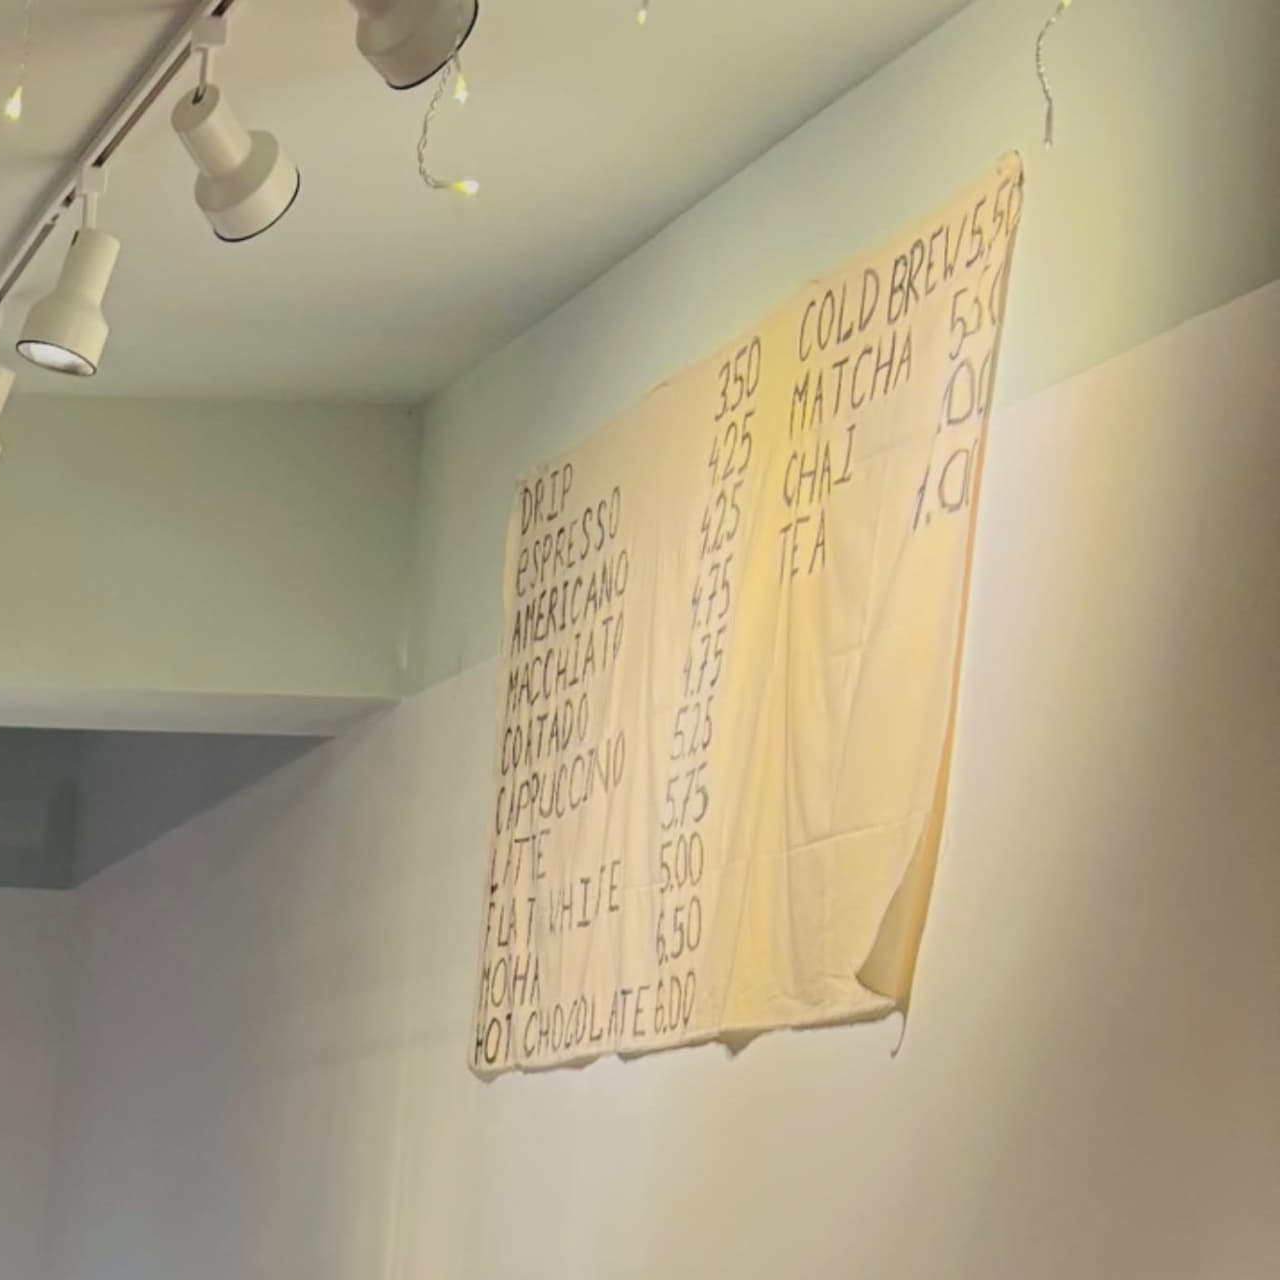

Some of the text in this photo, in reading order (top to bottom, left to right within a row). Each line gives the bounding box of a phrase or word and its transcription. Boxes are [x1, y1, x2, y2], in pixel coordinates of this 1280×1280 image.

[798, 267, 880, 362] COLD
[887, 212, 968, 326] BREW
[789, 326, 913, 441] MATCHA
[521, 462, 573, 536] DRIP
[782, 423, 857, 508] CHAI
[778, 508, 827, 586] TEA
[509, 548, 630, 658] AMERICANO
[504, 610, 625, 719] MACCHIATO
[495, 729, 626, 836] CAPPUCCINO
[483, 896, 537, 953] FLAT
[658, 831, 705, 894] 5.00
[478, 895, 703, 1014] MOHA 6.50
[474, 970, 697, 1067] HOT CHOCOLATE 6.00
